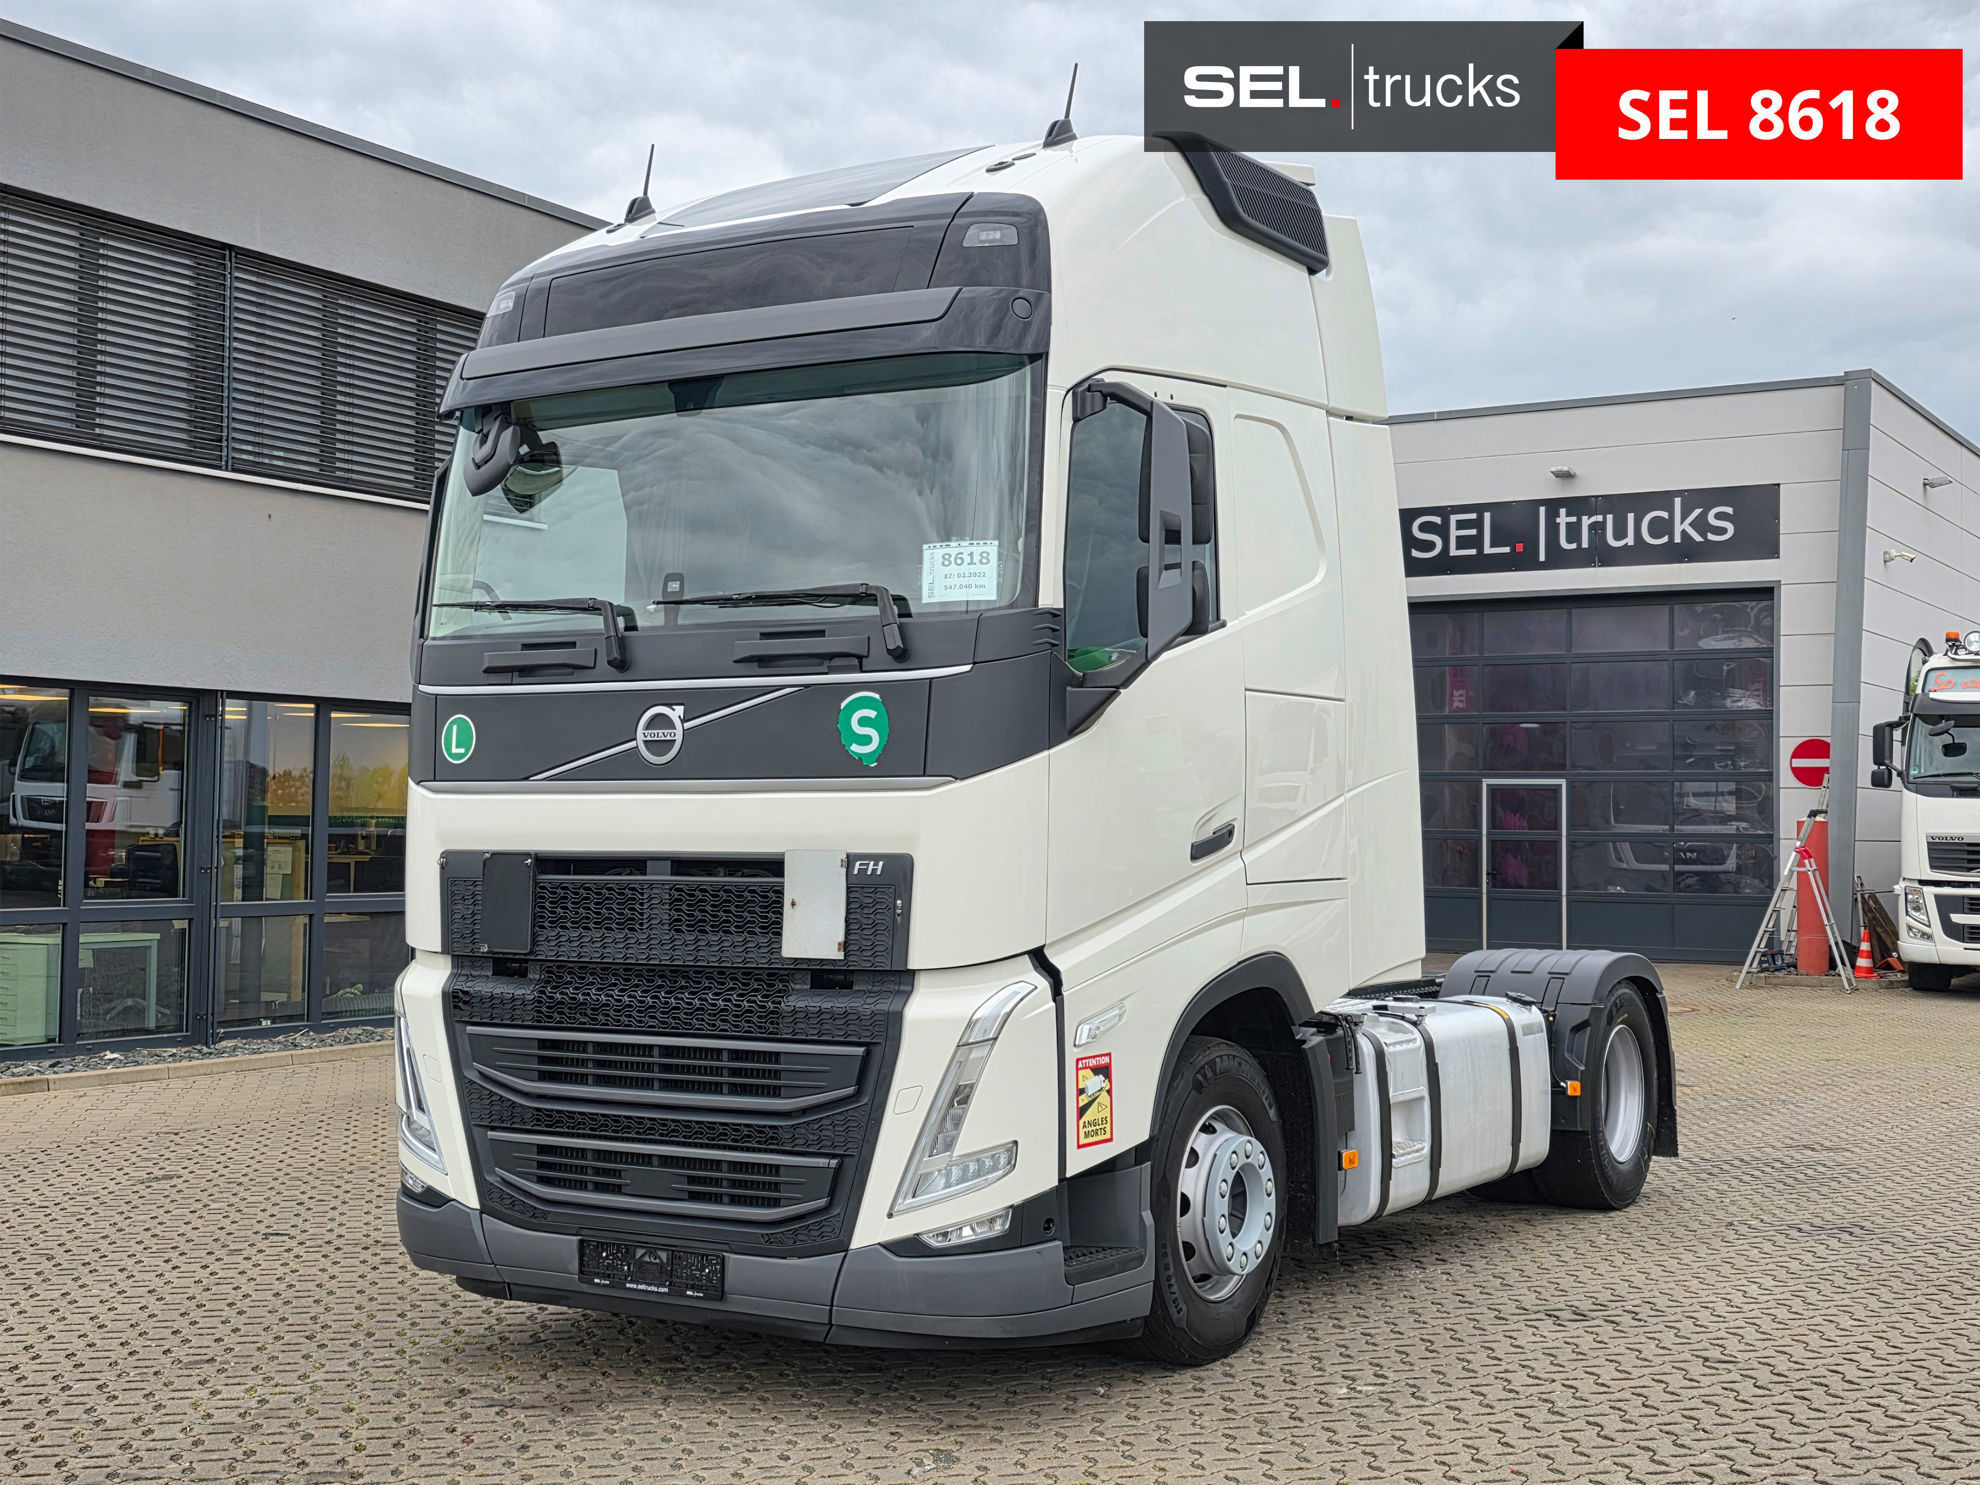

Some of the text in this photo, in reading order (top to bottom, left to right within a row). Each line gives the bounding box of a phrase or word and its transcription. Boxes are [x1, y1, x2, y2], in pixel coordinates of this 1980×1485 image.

[1555, 497, 1735, 550] trucks
[941, 550, 991, 567] 8618
[642, 731, 677, 739] VOLVO
[850, 708, 879, 754] S
[450, 724, 466, 754] L
[853, 860, 884, 875] FH
[1078, 1055, 1110, 1069] ATTENTION
[1082, 1116, 1109, 1130] ANGLES
[1083, 1126, 1107, 1140] MORTS
